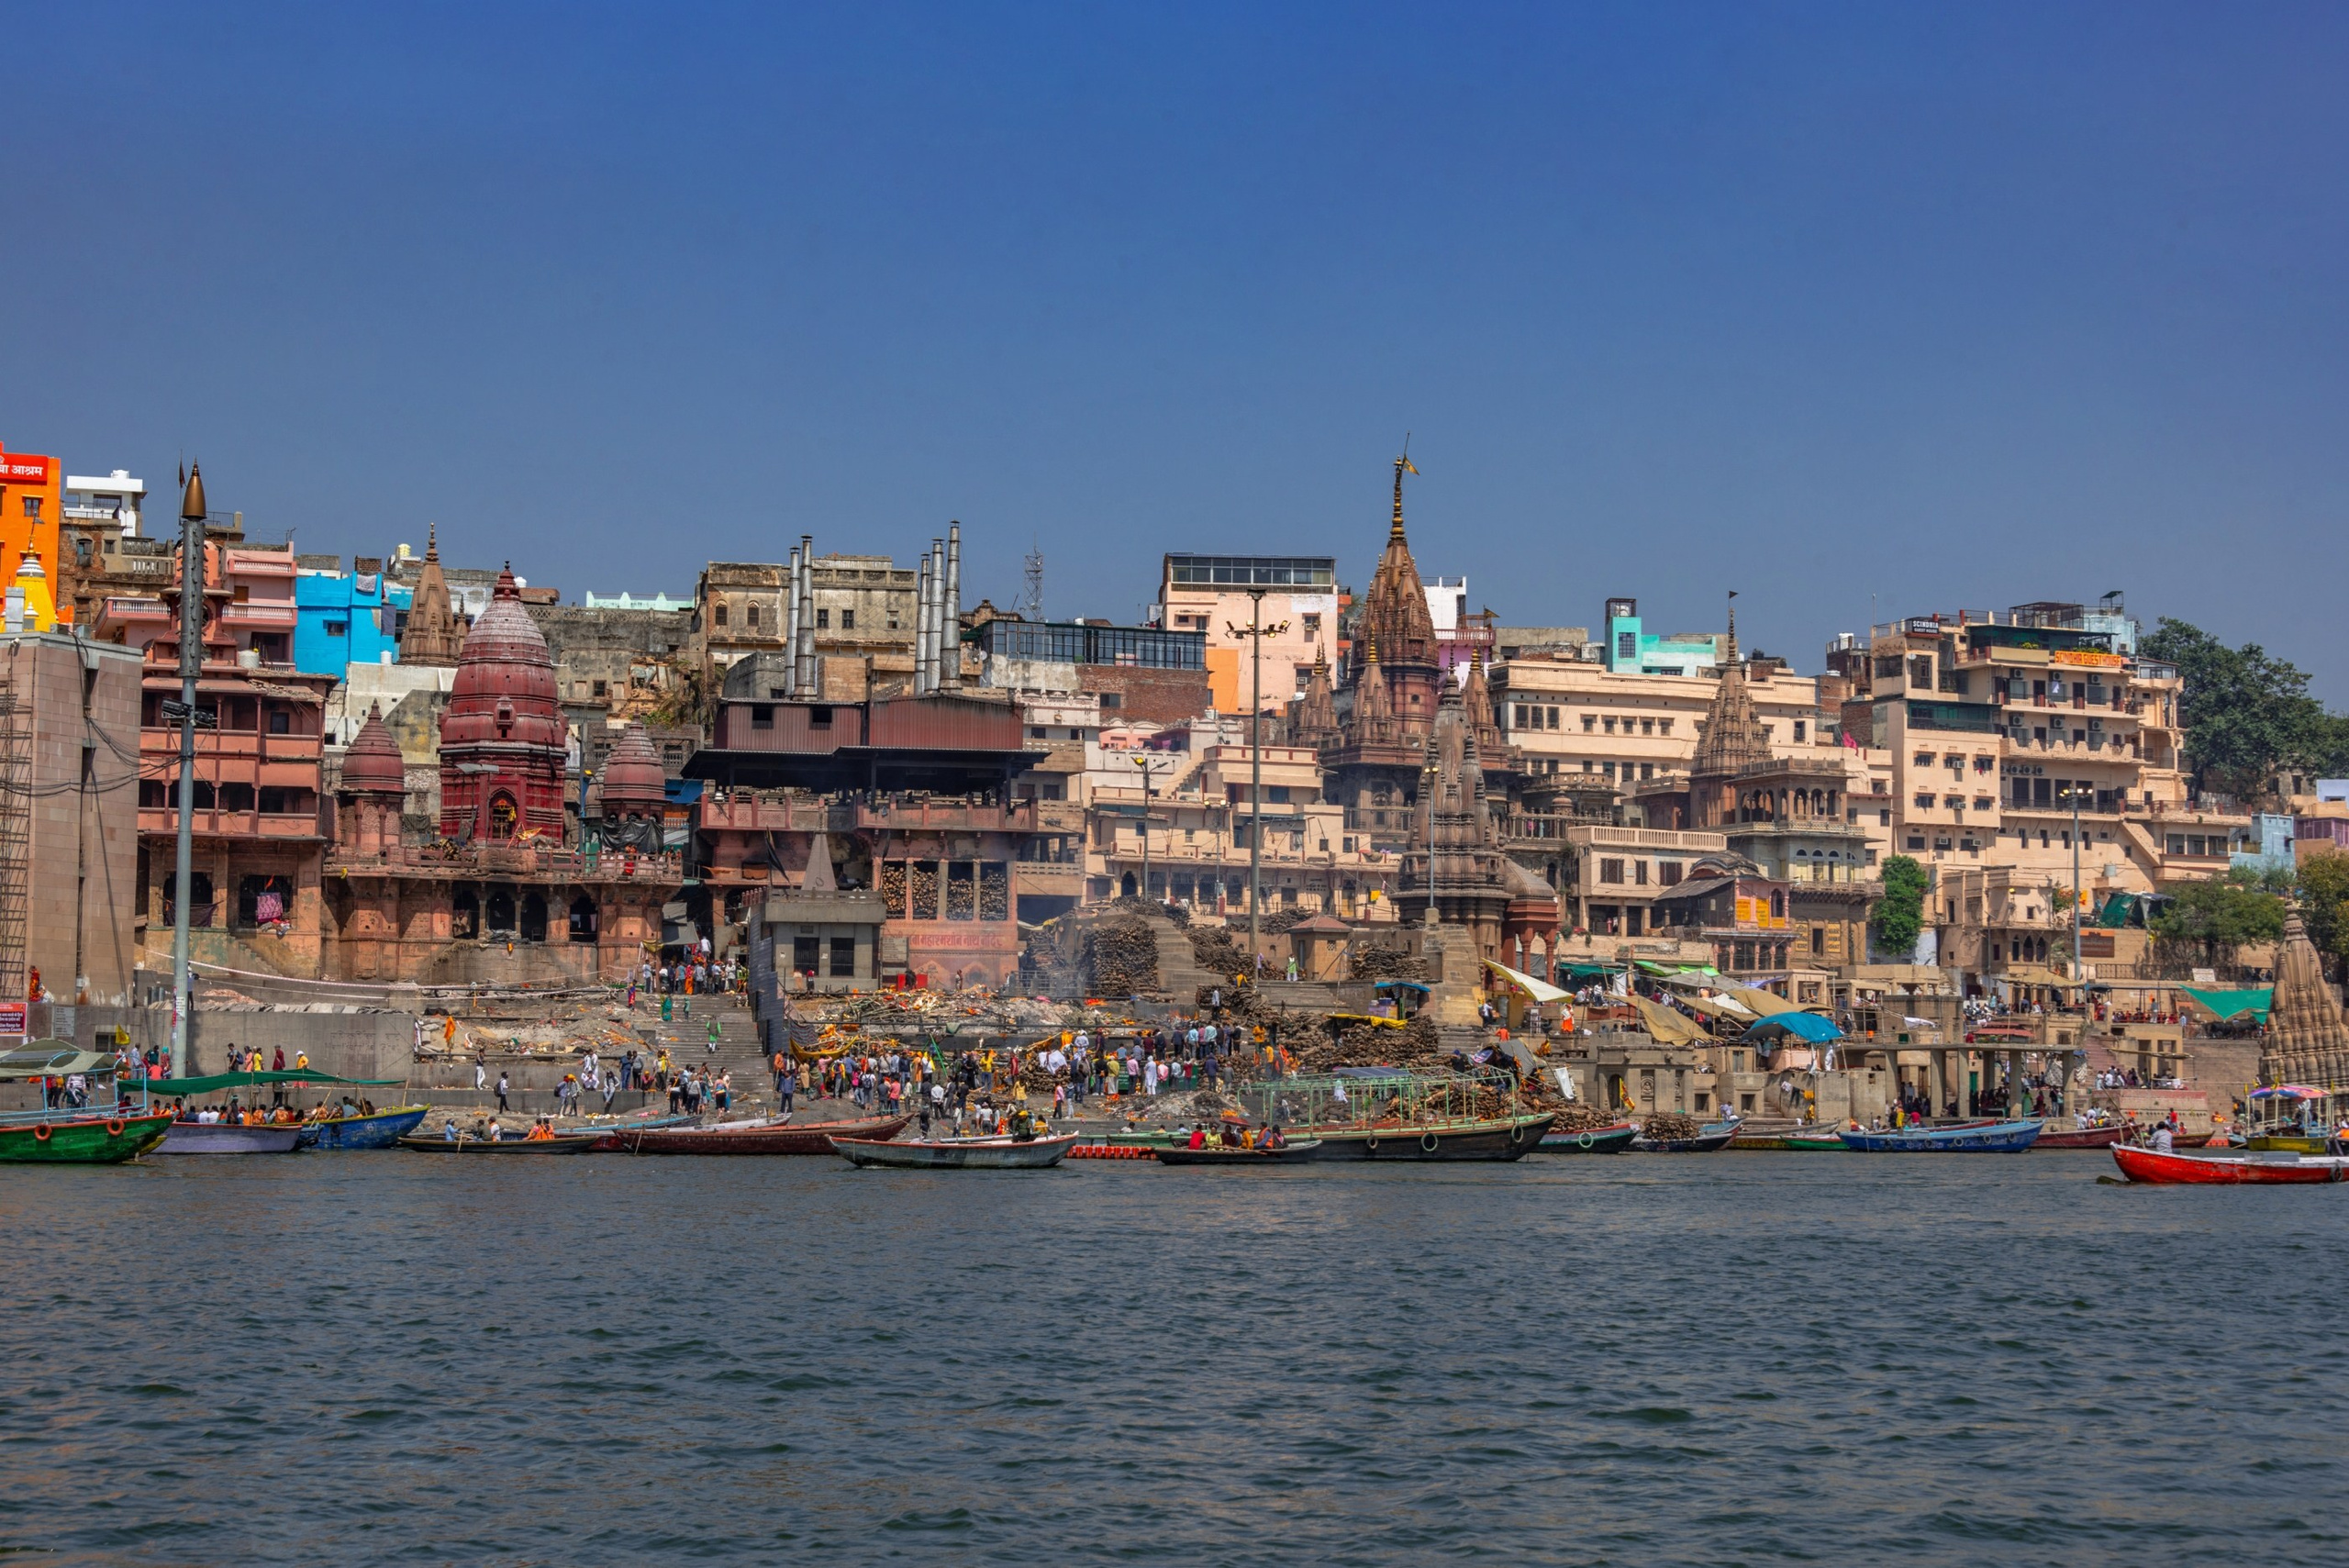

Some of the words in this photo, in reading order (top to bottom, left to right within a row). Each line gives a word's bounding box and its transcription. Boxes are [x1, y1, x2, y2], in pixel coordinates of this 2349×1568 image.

[11, 465, 43, 476] आश्रम
[2083, 654, 2101, 665] GUEST
[2101, 655, 2121, 666] HOUSE
[963, 934, 980, 946] नाथ
